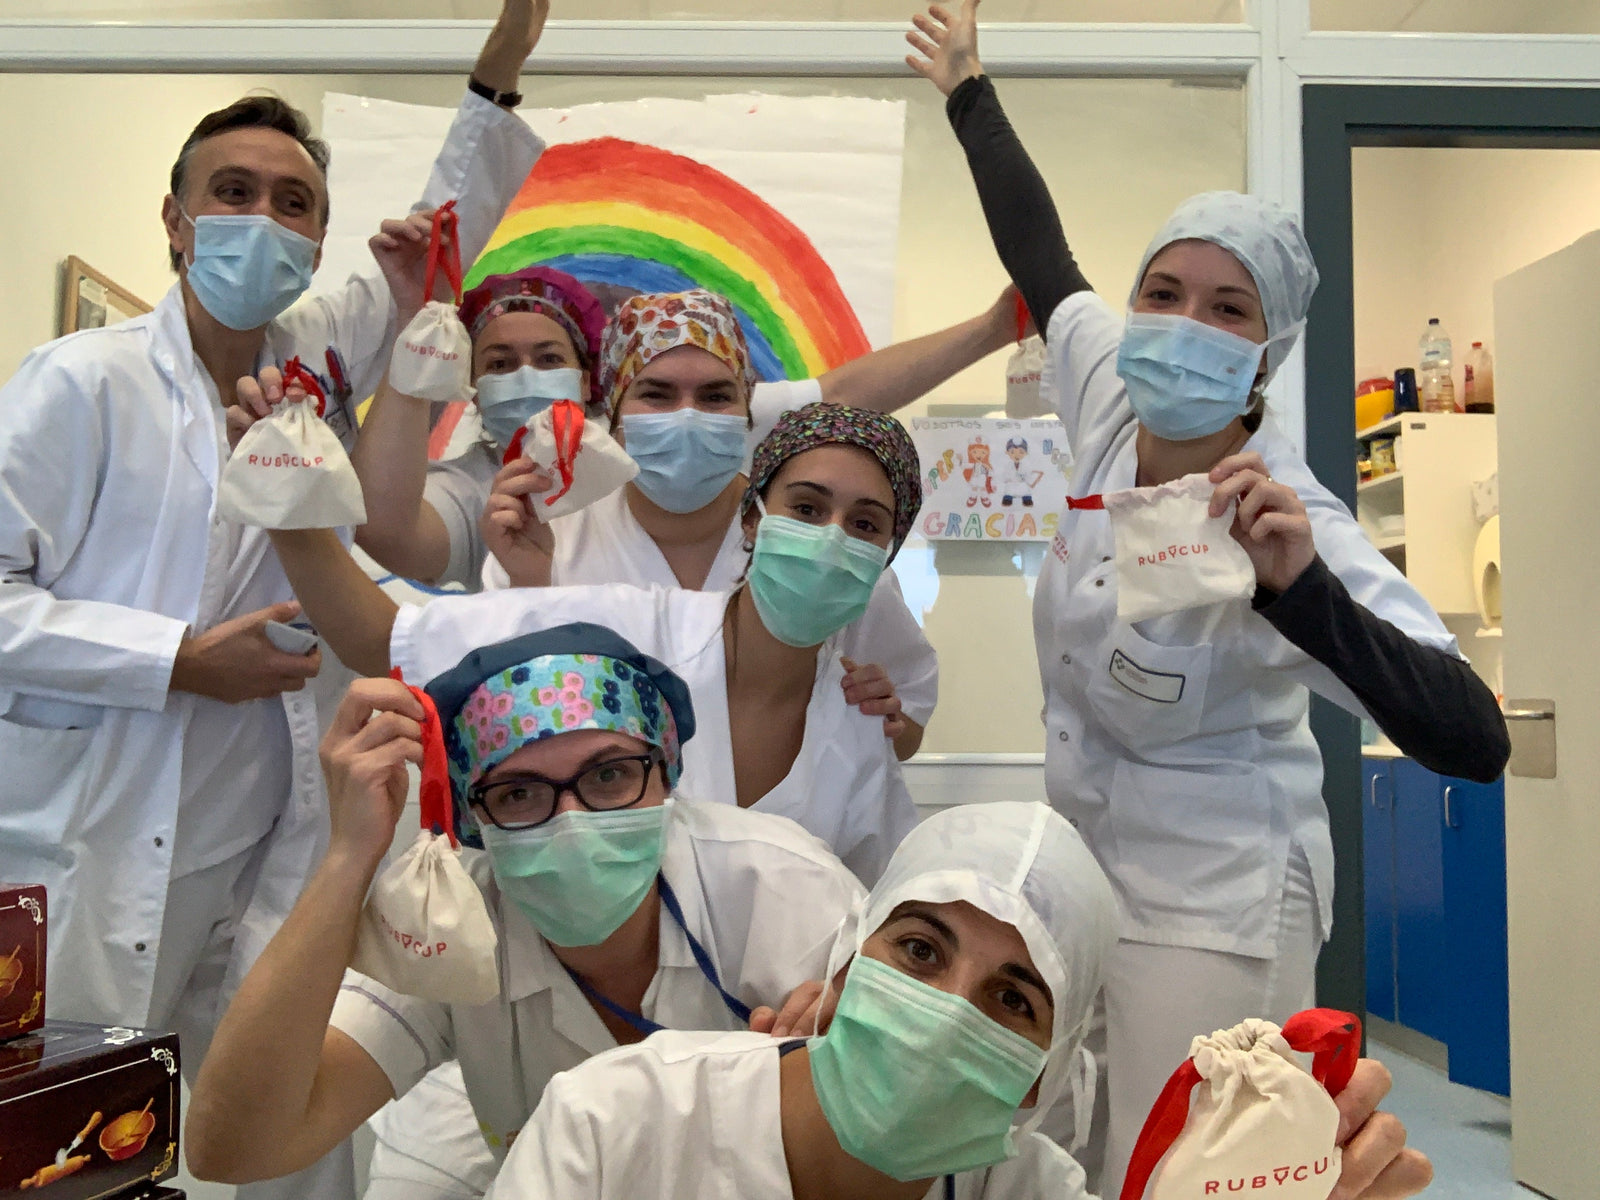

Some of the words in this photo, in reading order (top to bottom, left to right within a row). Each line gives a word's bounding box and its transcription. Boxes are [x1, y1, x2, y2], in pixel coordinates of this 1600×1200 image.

[1009, 371, 1041, 384] RUBYC
[248, 453, 324, 468] RUBYCUP
[923, 512, 1059, 538] GRACIAS
[1138, 544, 1209, 566] RUBYCUP
[1204, 1156, 1329, 1195] RUBYCU
